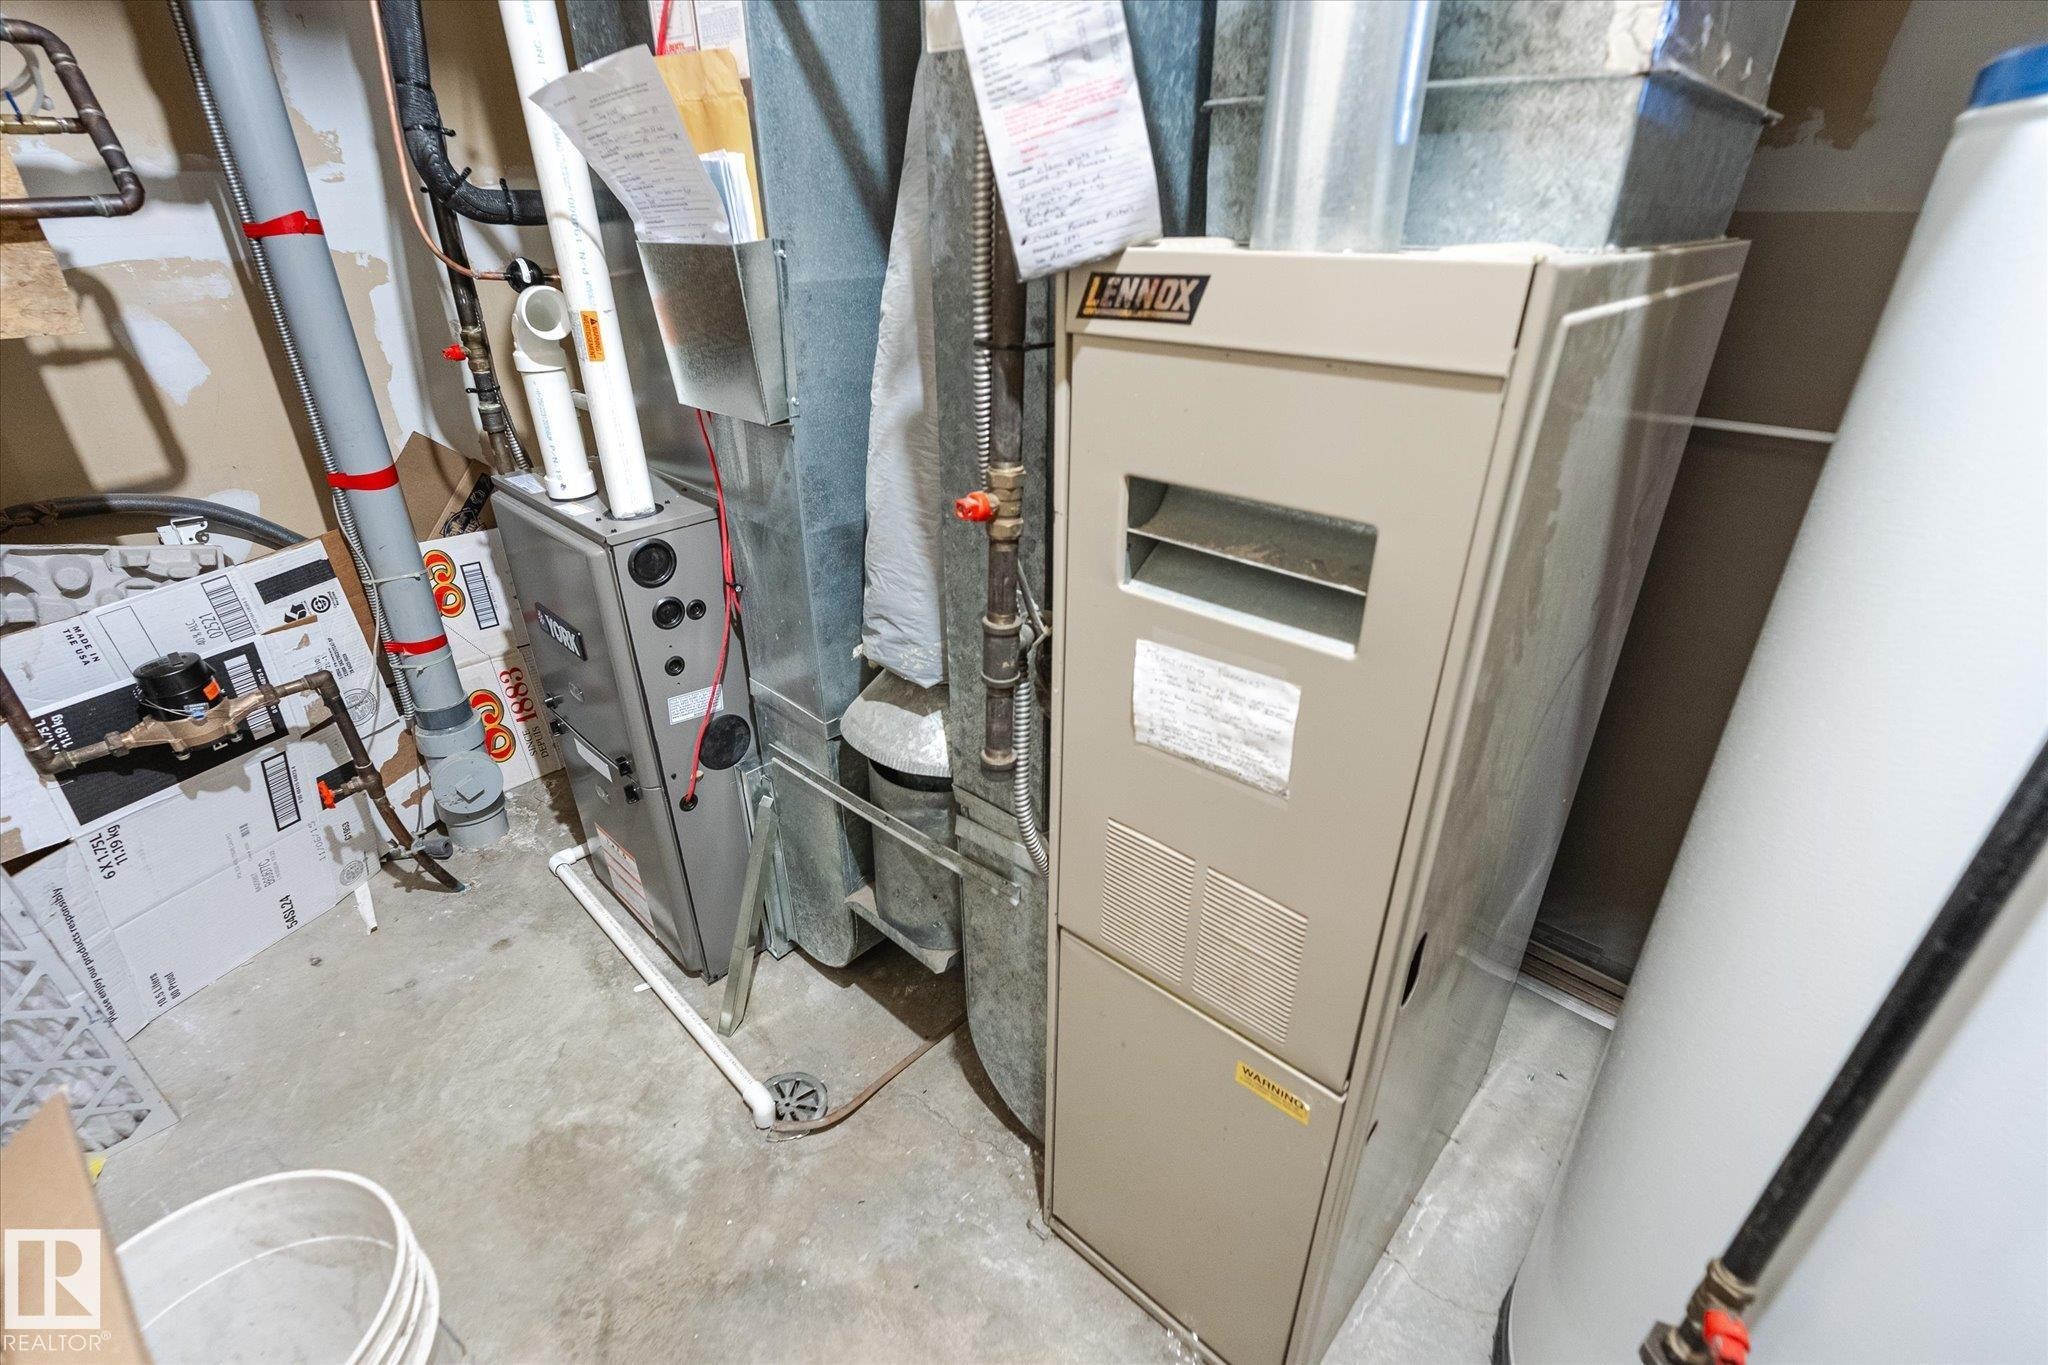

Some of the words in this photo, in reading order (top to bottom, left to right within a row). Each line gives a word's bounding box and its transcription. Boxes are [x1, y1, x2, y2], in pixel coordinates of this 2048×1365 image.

[1085, 276, 1200, 312] LENNOX
[198, 612, 224, 639] 02521
[544, 614, 581, 657] YORK
[62, 628, 78, 646] THE
[75, 648, 91, 666] USA
[72, 625, 93, 650] MADE
[89, 652, 101, 663] IN
[499, 667, 539, 723] 1883
[51, 713, 64, 728] kg
[54, 725, 74, 749] 11.19
[522, 728, 537, 757] SINCE
[531, 725, 550, 759] DEPUIS
[89, 832, 109, 863] 1.75L
[107, 824, 121, 841] kg
[109, 840, 128, 867] 11.19
[103, 870, 116, 880] 6
[52, 886, 77, 935] responsibly
[279, 894, 299, 930] 54SL24
[71, 930, 95, 967] products
[86, 962, 98, 979] our
[93, 977, 108, 1000] enjoy
[102, 997, 120, 1024] Please
[1242, 1065, 1304, 1110] WARNING
